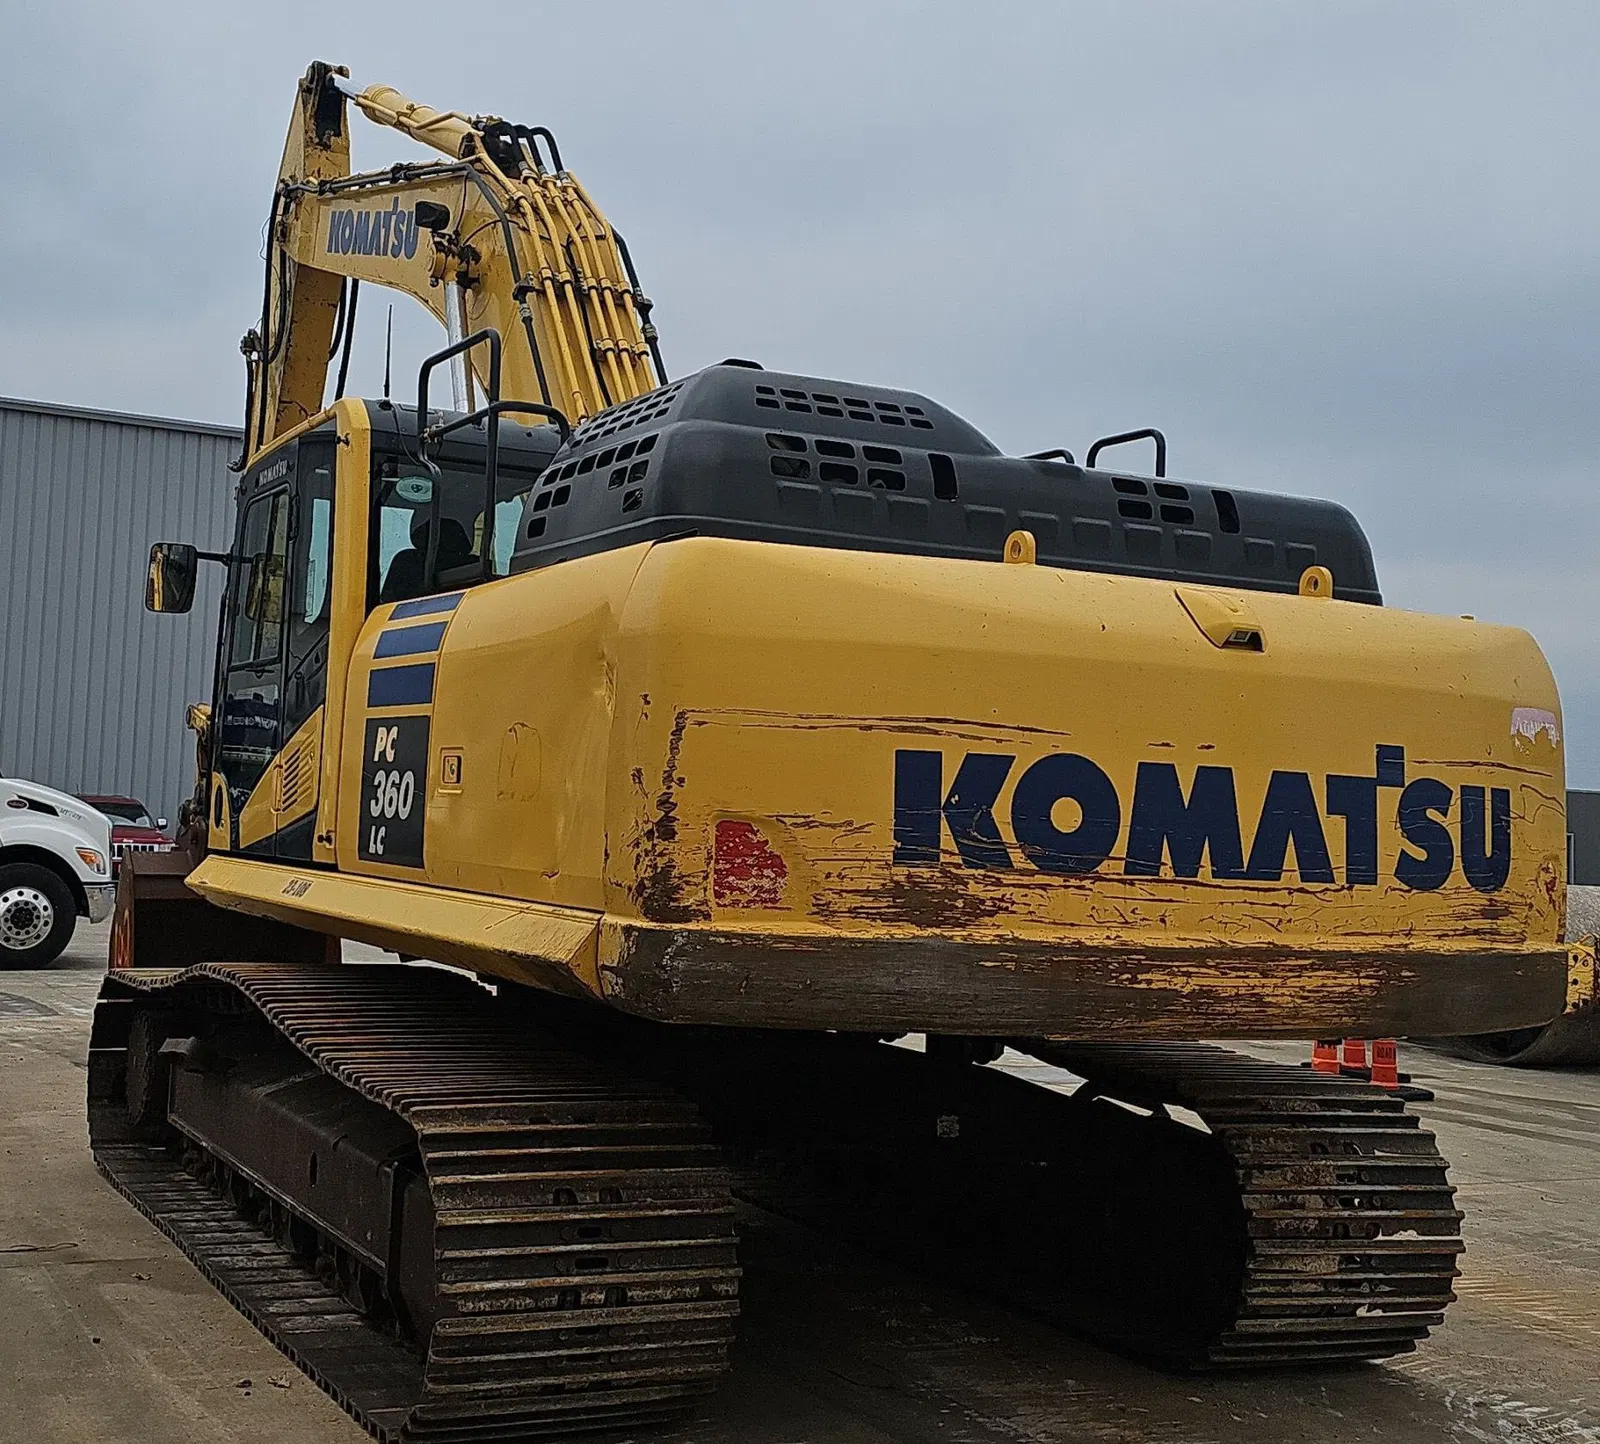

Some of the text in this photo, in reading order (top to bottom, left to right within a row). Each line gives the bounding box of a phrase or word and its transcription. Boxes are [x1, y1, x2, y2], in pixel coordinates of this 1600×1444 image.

[327, 196, 419, 260] KOMATSU
[373, 726, 399, 762] PC
[370, 770, 415, 820] 360
[894, 744, 1511, 893] KOMATSU
[368, 825, 387, 855] LC
